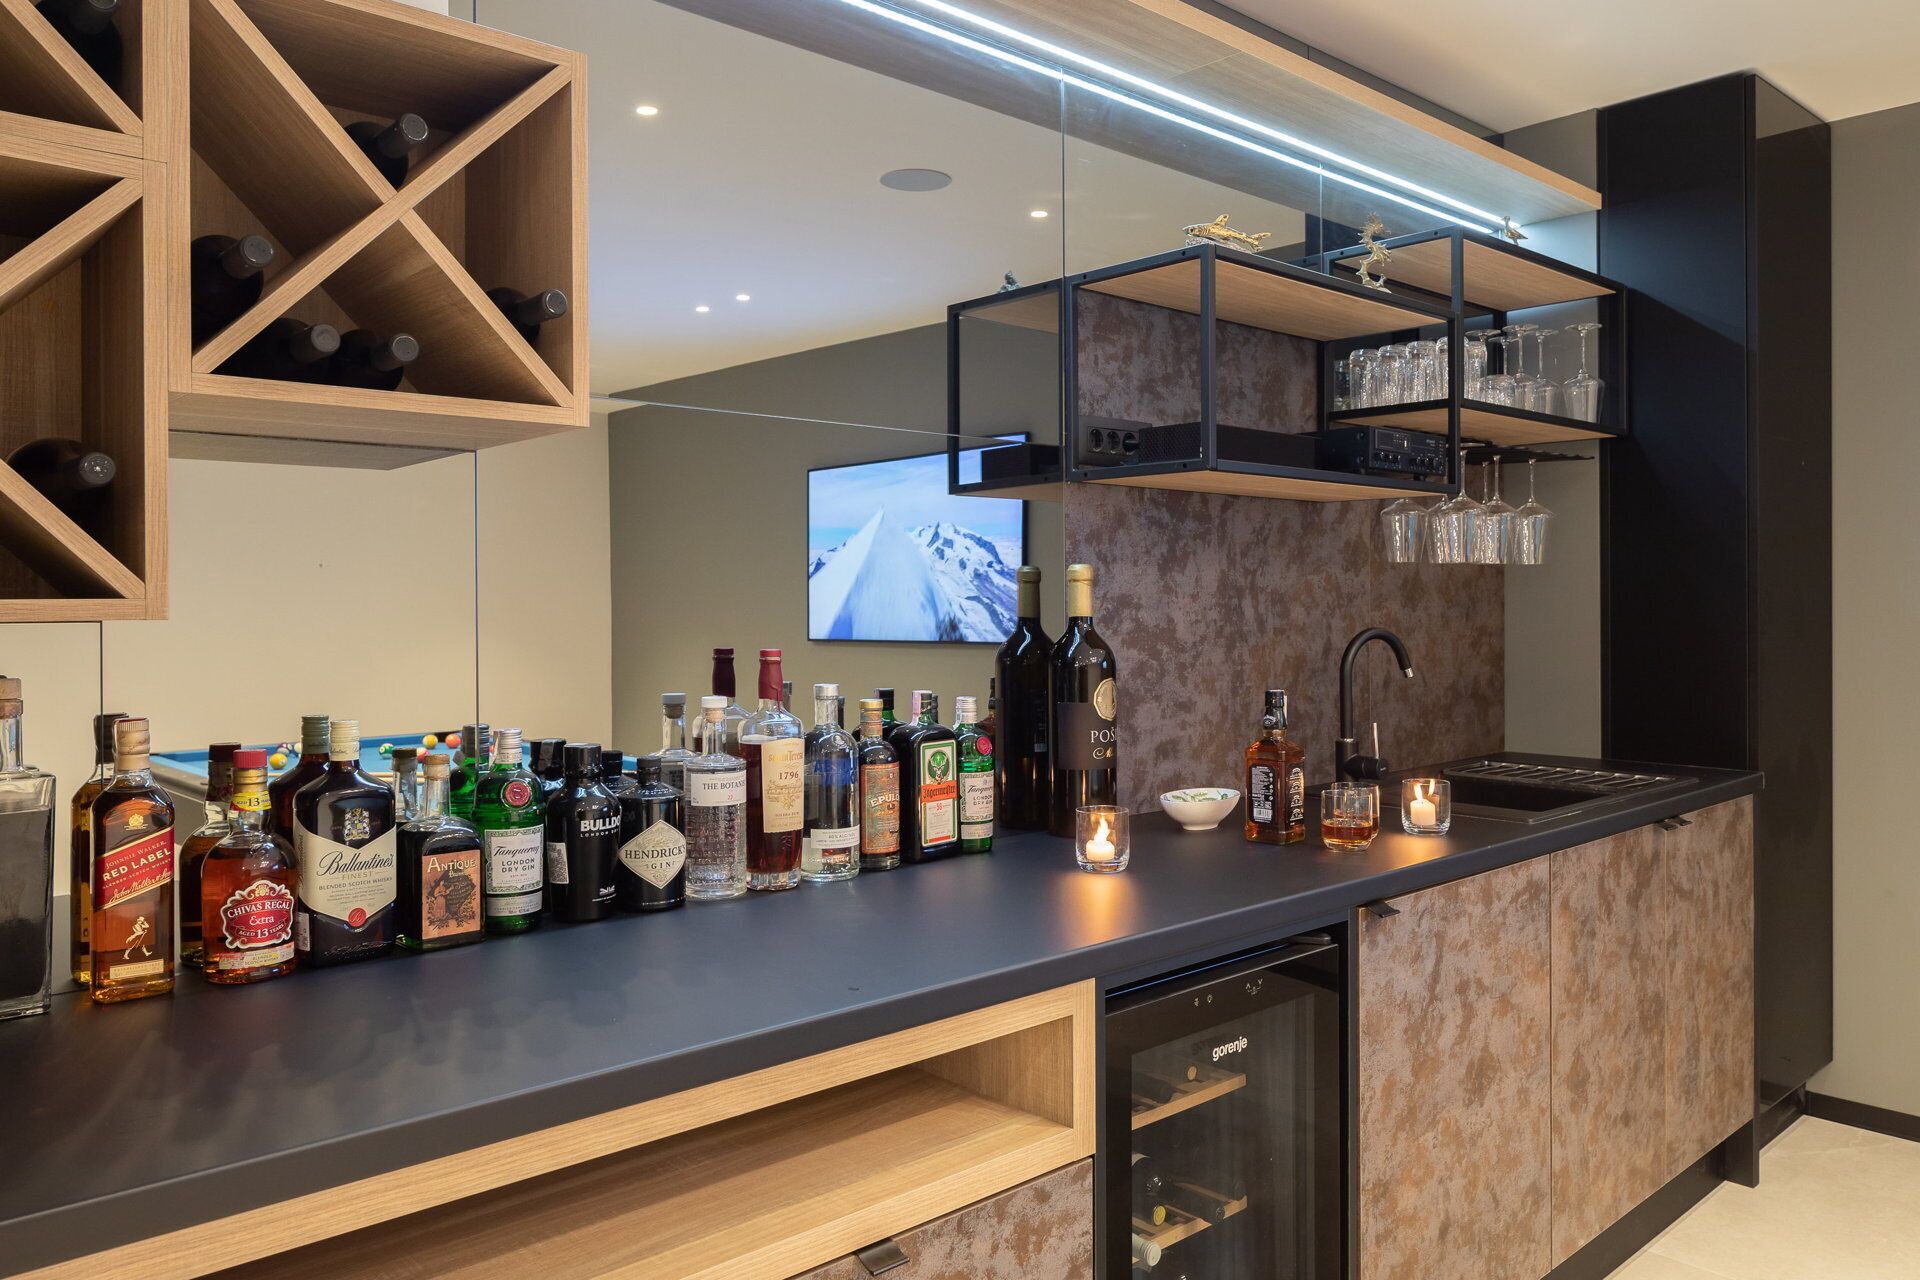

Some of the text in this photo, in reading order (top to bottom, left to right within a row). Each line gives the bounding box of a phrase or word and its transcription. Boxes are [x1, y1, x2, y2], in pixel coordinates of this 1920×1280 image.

[779, 770, 799, 780] 1796
[702, 782, 719, 790] THE
[248, 797, 260, 807] 13
[105, 840, 166, 870] JOHNNIE WALKER
[493, 845, 540, 858] Tanqueray
[102, 847, 171, 881] RED LABEL
[316, 850, 394, 877] Ballantine's
[501, 857, 535, 867] LONDON
[521, 864, 535, 872] GIN
[651, 861, 671, 870] GIN
[342, 871, 372, 880] FINEST
[318, 883, 347, 891] BLENDED
[348, 879, 371, 887] SCOTCH
[372, 876, 393, 884] WHISKY
[227, 900, 291, 918] CHIVAS REGAL
[249, 915, 275, 926] Extra
[256, 928, 269, 939] 13
[269, 923, 284, 933] YEARS
[1212, 1035, 1248, 1062] gorenje
